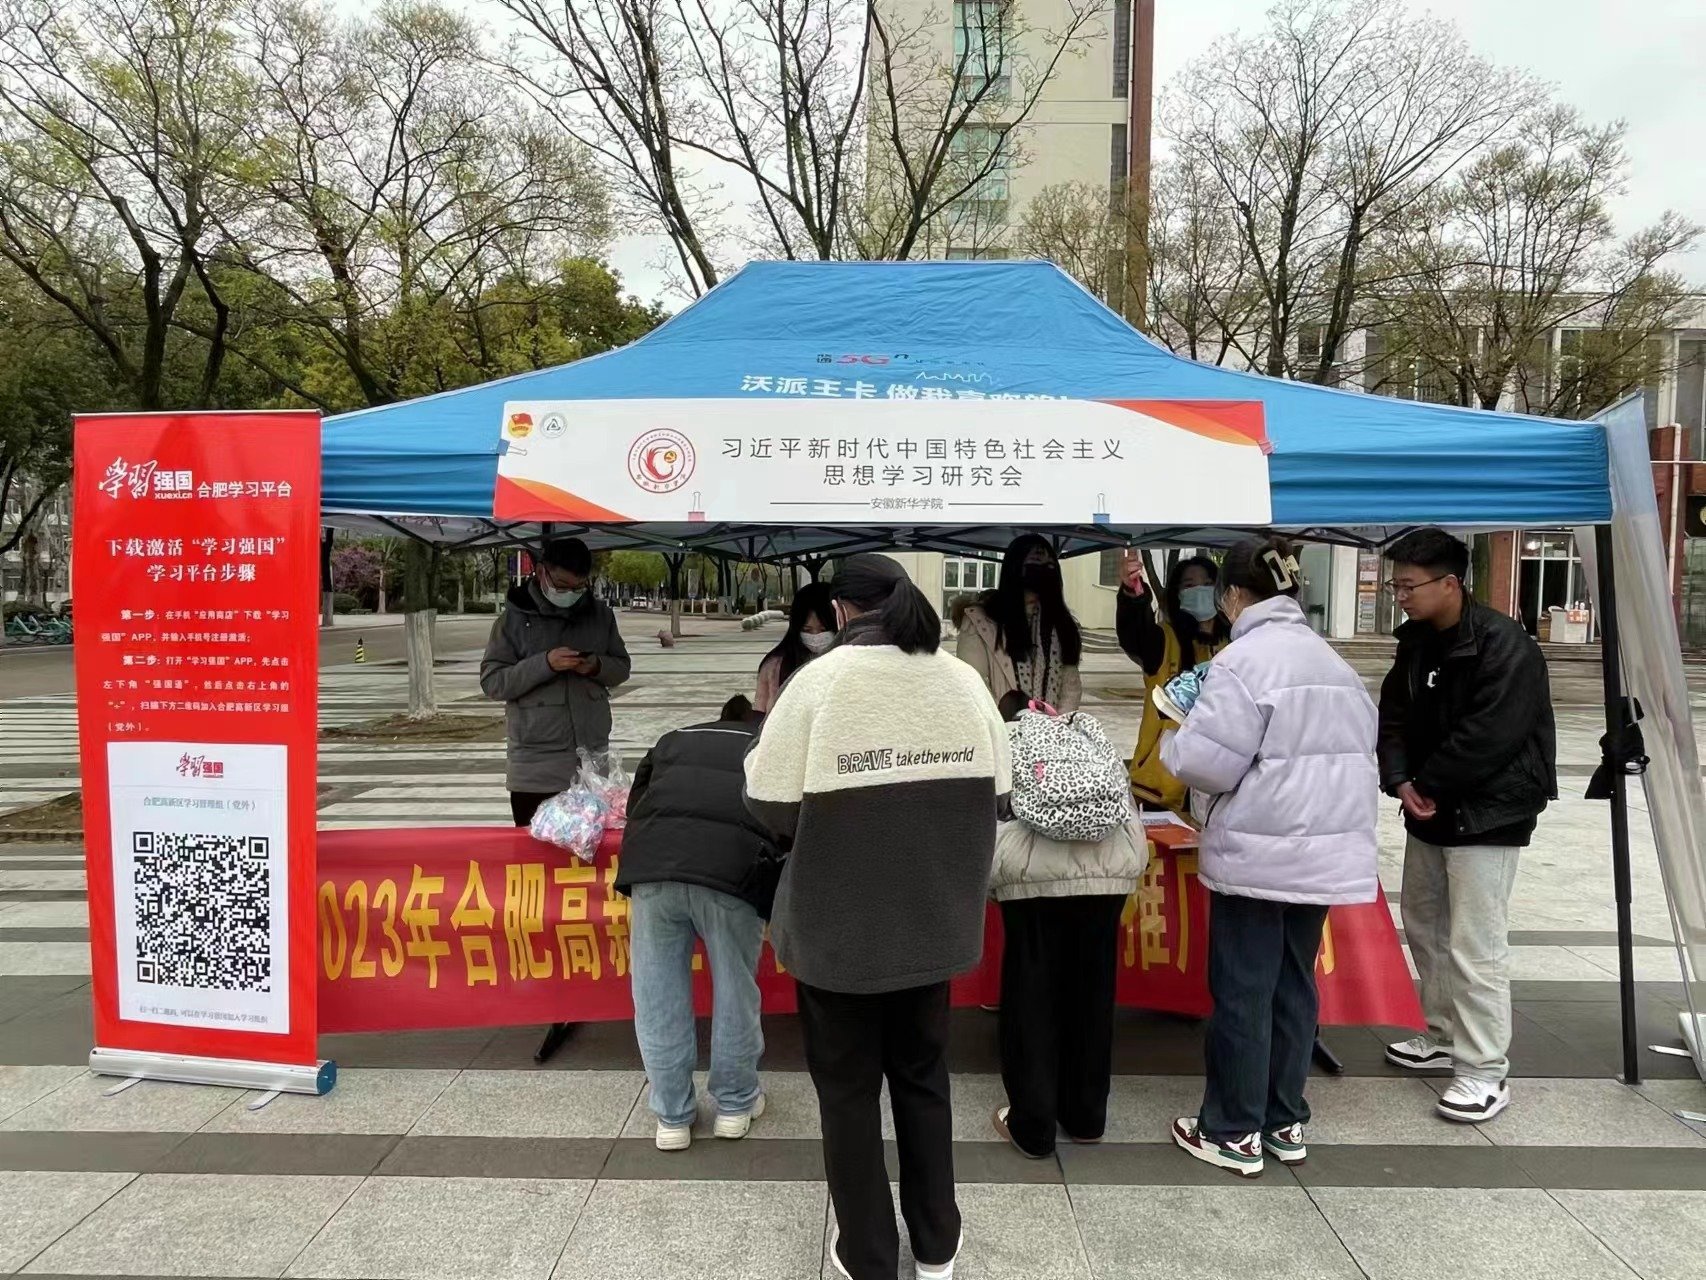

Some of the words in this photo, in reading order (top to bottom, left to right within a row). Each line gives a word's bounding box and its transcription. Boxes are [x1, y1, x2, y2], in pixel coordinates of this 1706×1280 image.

[741, 374, 879, 399] 沃派王卡
[722, 437, 1125, 461] 习近平新时代中国特色社会主义
[823, 464, 1023, 487] 思想学习研究会
[197, 481, 292, 498] 合肥学习平台
[870, 497, 944, 510] 安徽新华学院
[147, 563, 257, 582] 学习平台步骤
[837, 749, 893, 775] BRAVE
